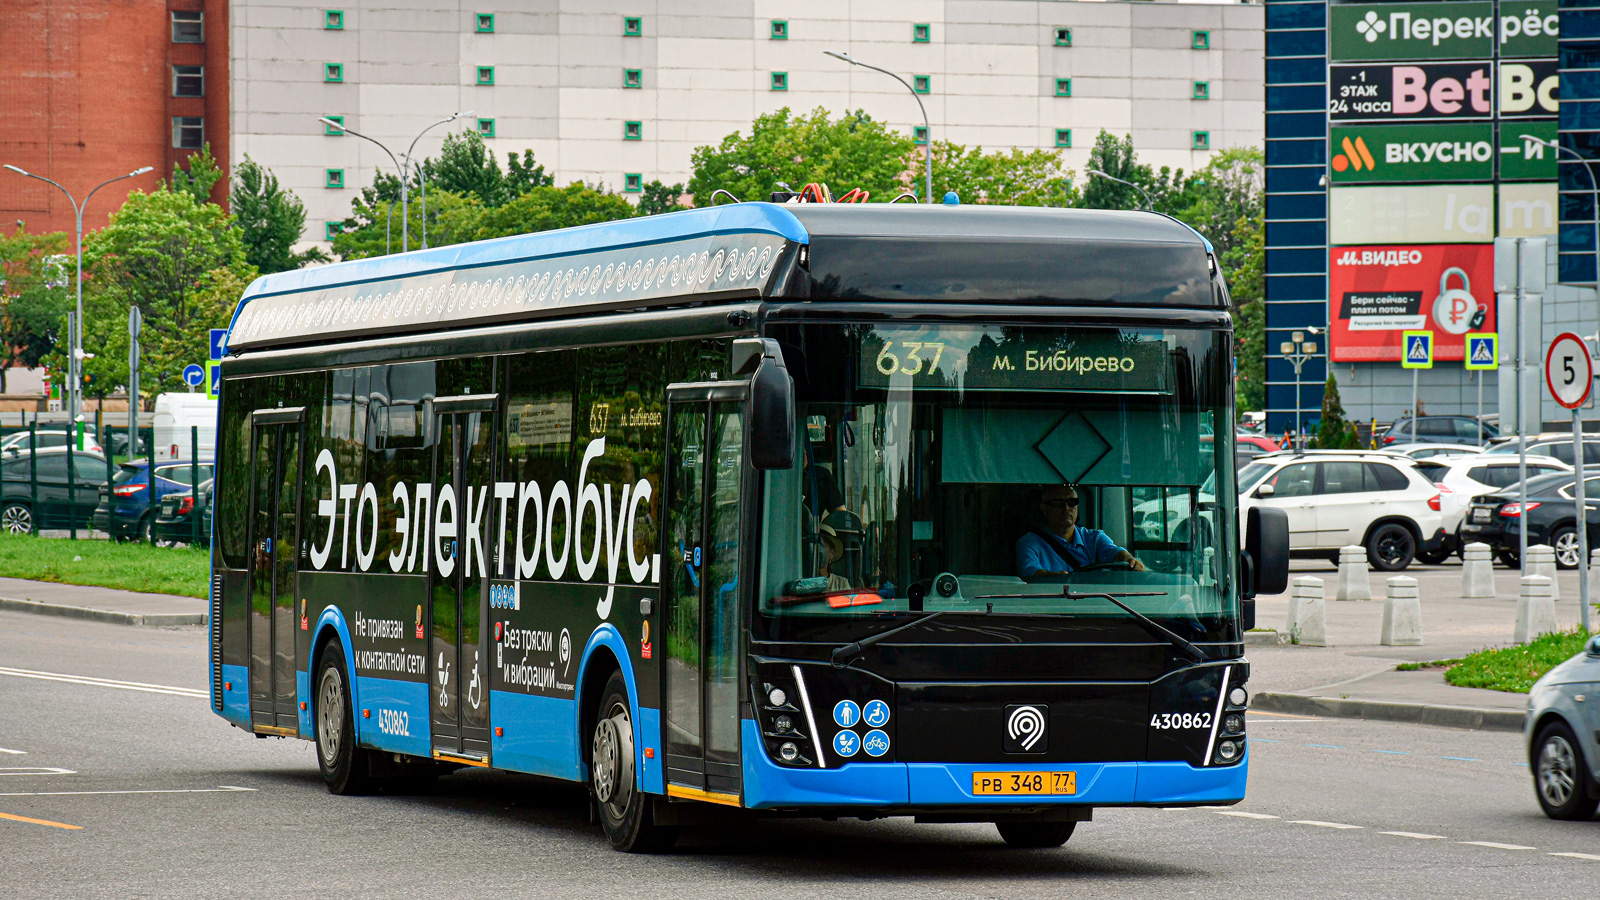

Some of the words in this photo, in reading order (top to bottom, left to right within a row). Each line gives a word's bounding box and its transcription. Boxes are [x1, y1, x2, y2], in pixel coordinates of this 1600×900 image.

[1340, 85, 1378, 97] ЭТАЖ
[1330, 99, 1349, 113] 24
[1352, 101, 1391, 113] часа
[1350, 295, 1374, 306] Бери
[1375, 294, 1408, 304] сейчас
[1350, 306, 1377, 314] плати
[1378, 305, 1406, 314] потом
[876, 340, 945, 376] 637
[992, 355, 1016, 371] м.
[1025, 349, 1135, 375] Бибирево
[1563, 355, 1575, 386] 5
[589, 402, 610, 434] 637
[310, 448, 379, 571] Это
[388, 435, 661, 620] электробус.
[355, 611, 367, 637] Не
[367, 618, 404, 644] привязан
[504, 620, 520, 650] Без
[521, 629, 553, 657] тряски
[355, 650, 361, 664] к
[361, 647, 405, 673] контактной
[406, 653, 426, 675] сети
[503, 663, 510, 683] и
[511, 656, 555, 692] вибраций
[378, 708, 410, 737] 430862
[1150, 712, 1212, 730] 430862
[1010, 774, 1043, 792] 348
[1053, 773, 1070, 787] 77
